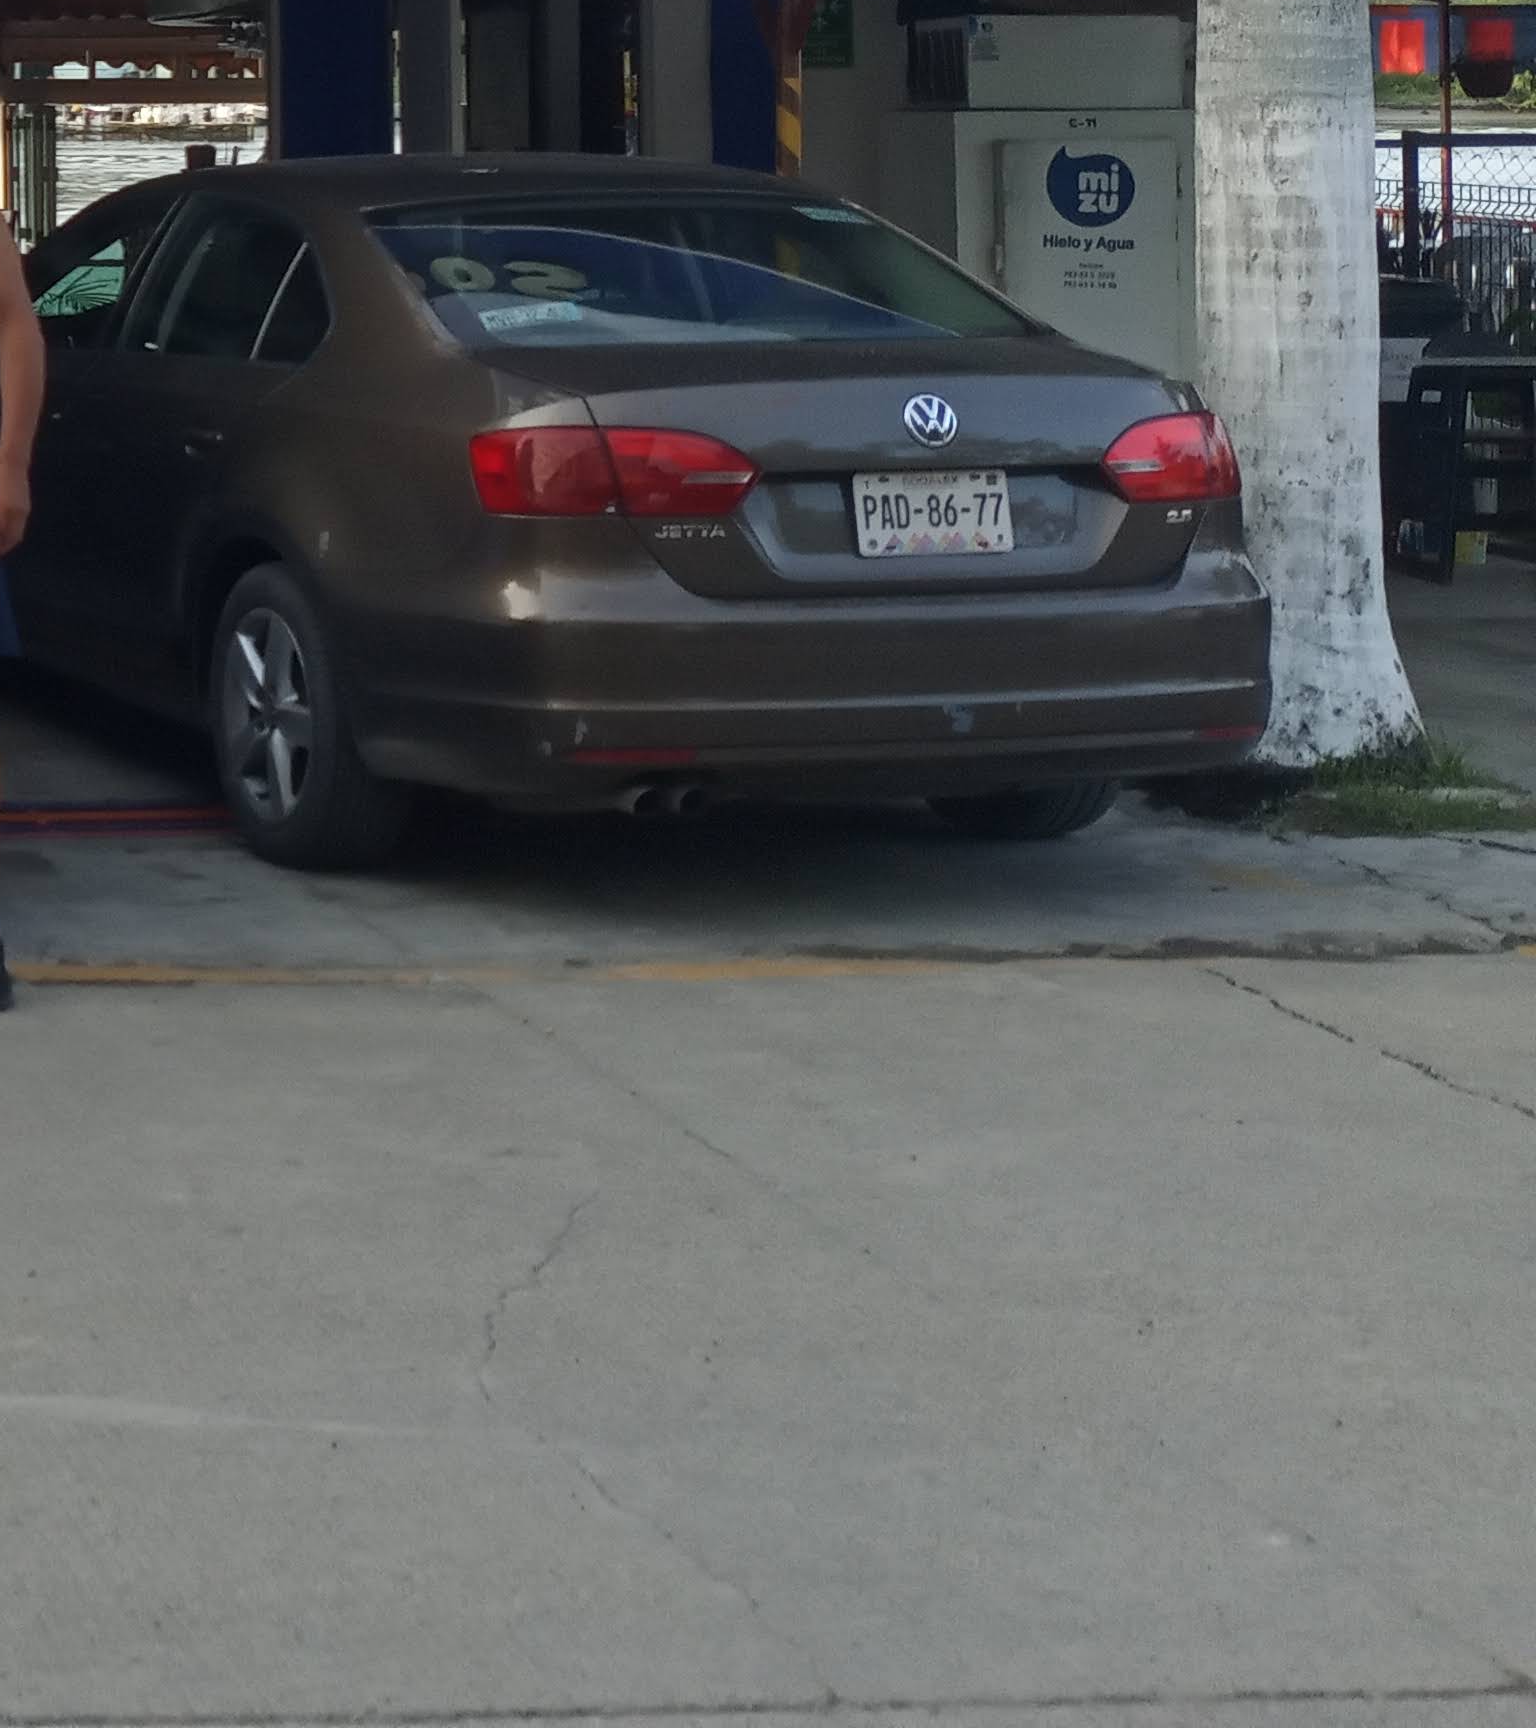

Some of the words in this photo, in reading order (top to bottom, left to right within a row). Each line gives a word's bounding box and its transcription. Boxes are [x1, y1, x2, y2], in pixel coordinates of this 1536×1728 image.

[1042, 234, 1081, 250] Hielo
[1083, 237, 1094, 253] y
[1095, 236, 1135, 253] Agua
[862, 492, 1004, 531] PAD-86-77
[654, 523, 726, 539] JETTA
